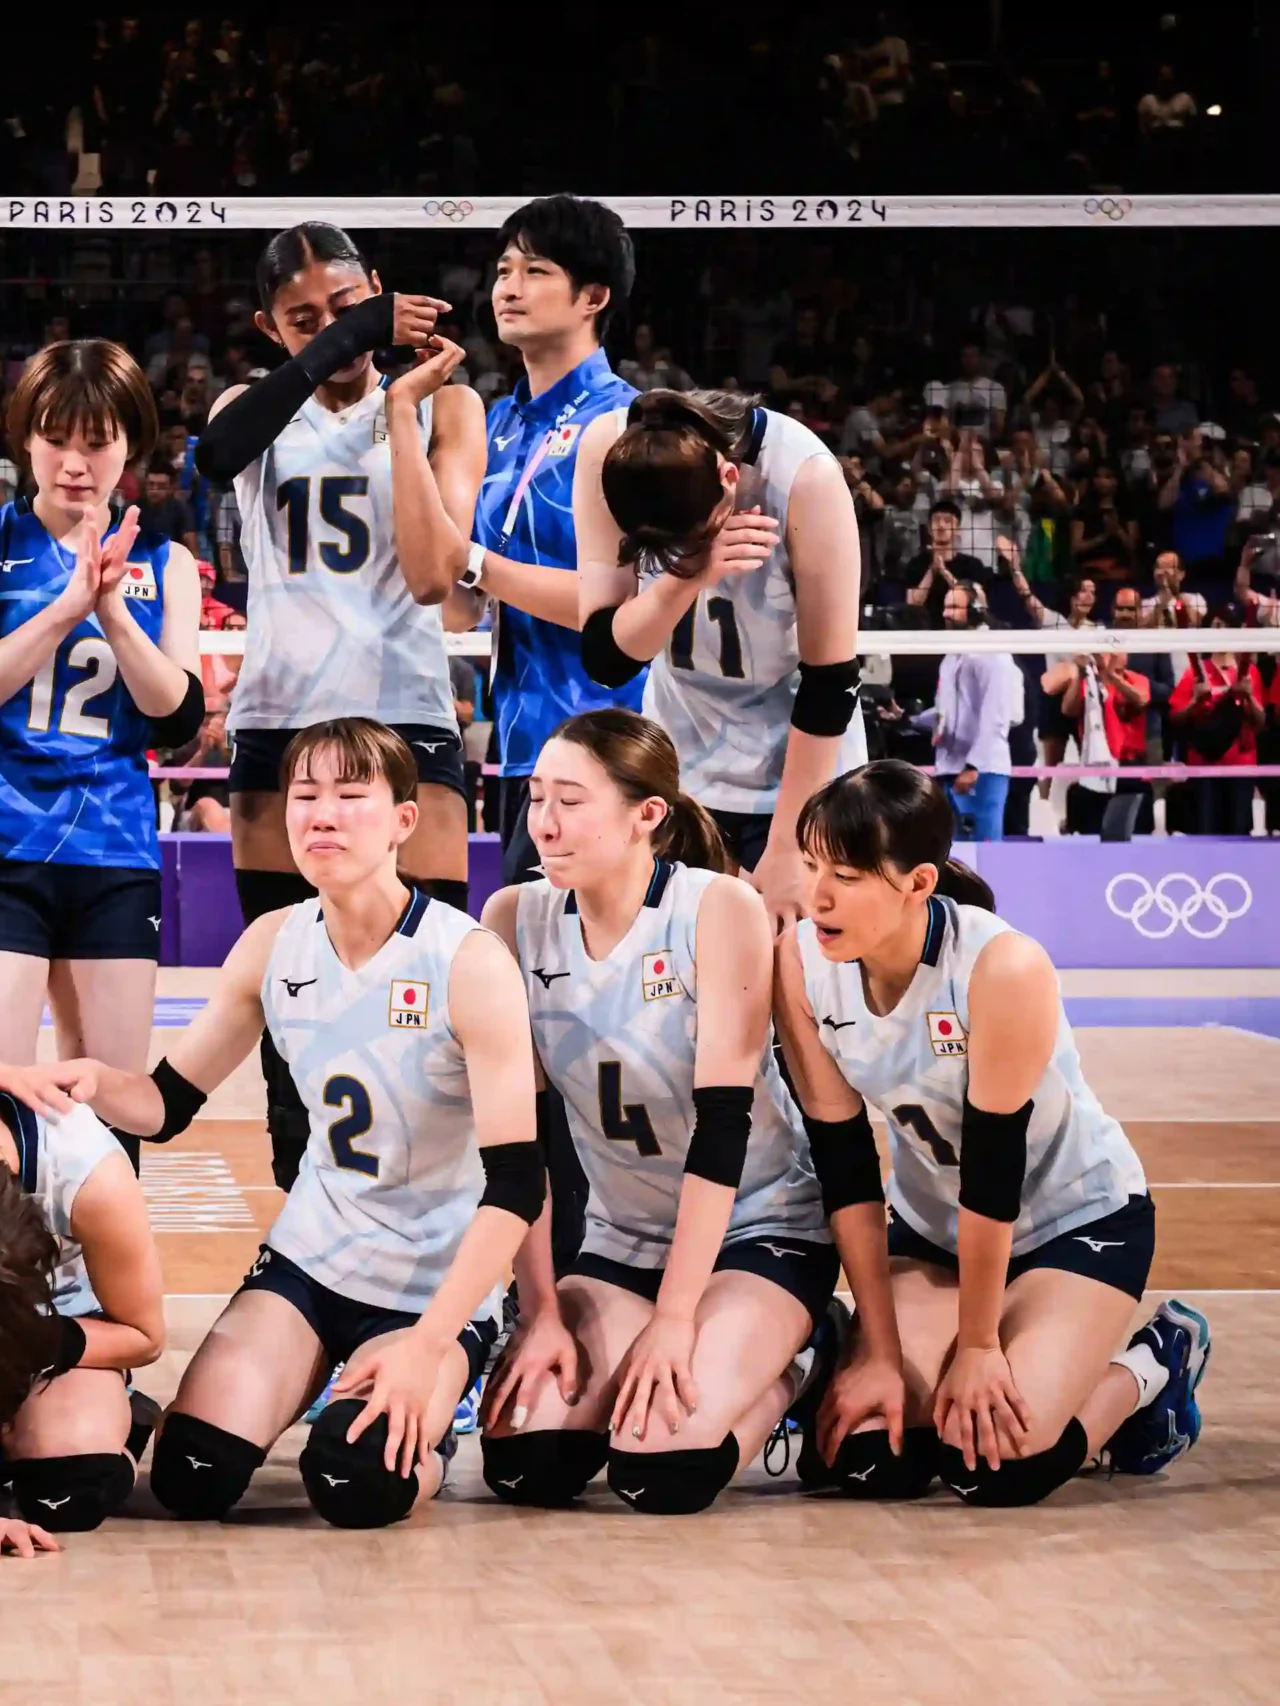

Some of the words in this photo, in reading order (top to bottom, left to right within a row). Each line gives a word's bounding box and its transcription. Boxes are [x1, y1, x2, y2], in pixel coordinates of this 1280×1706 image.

[131, 201, 227, 225] 2024
[792, 199, 887, 222] 2024
[276, 474, 371, 576] 15
[125, 586, 149, 597] JPN
[26, 636, 118, 740] 12
[650, 981, 673, 997] JPN
[396, 1012, 421, 1026] JPN
[939, 1042, 964, 1054] JPN
[597, 1060, 664, 1158] 4
[322, 1072, 380, 1180] 2
